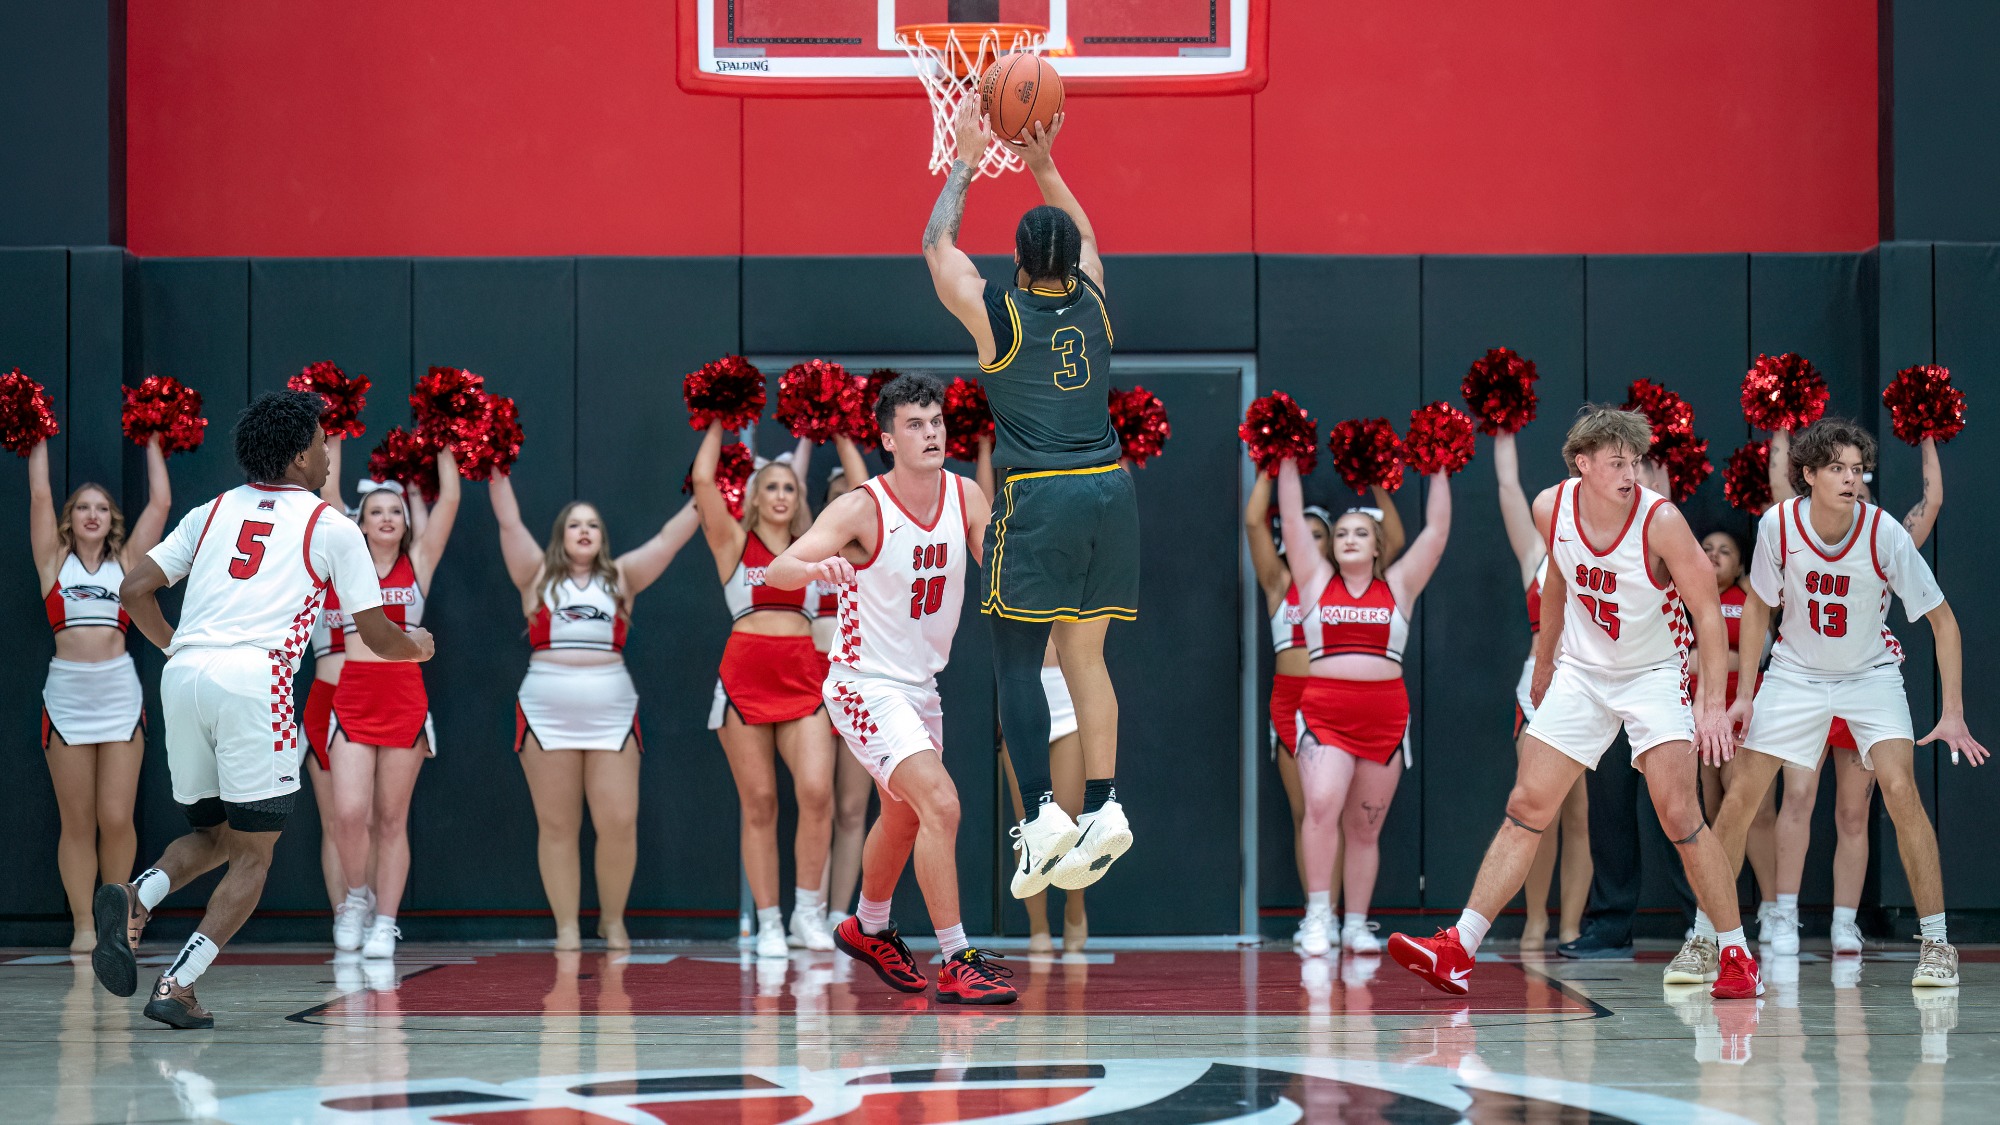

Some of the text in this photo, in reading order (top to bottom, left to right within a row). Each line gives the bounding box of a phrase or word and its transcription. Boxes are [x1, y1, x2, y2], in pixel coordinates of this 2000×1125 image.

[716, 60, 769, 72] SPALDING
[1051, 325, 1091, 391] 3
[228, 519, 275, 580] 5
[912, 542, 948, 571] SOU
[1575, 563, 1618, 595] SOU
[1805, 570, 1851, 598] SOU
[910, 575, 947, 620] 20
[1322, 608, 1390, 622] RAIDERS
[1807, 598, 1848, 638] 13
